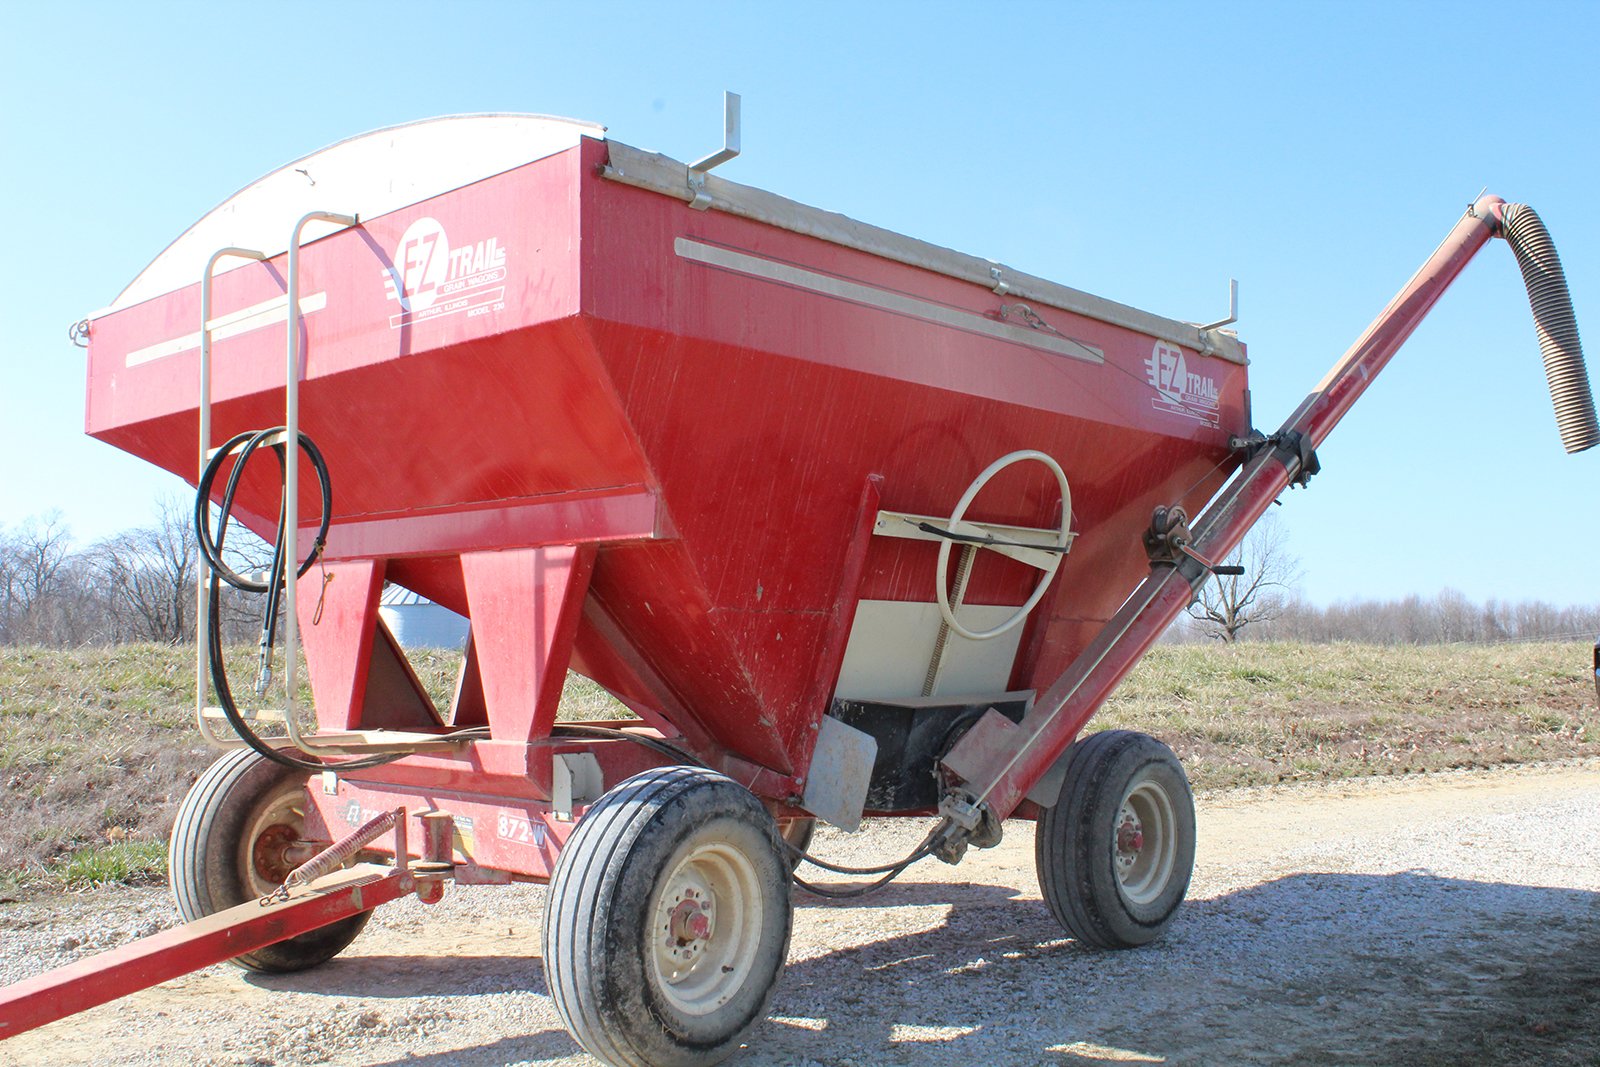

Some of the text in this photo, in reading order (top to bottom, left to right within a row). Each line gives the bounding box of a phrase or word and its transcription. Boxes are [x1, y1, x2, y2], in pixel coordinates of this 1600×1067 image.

[449, 237, 505, 279] TRAIL
[443, 271, 499, 293] GRAIN WAGONS
[444, 299, 469, 311] ILLINOIS
[467, 305, 491, 318] MODEL
[1187, 373, 1219, 403] TRAIL
[499, 815, 546, 846] 872-W
